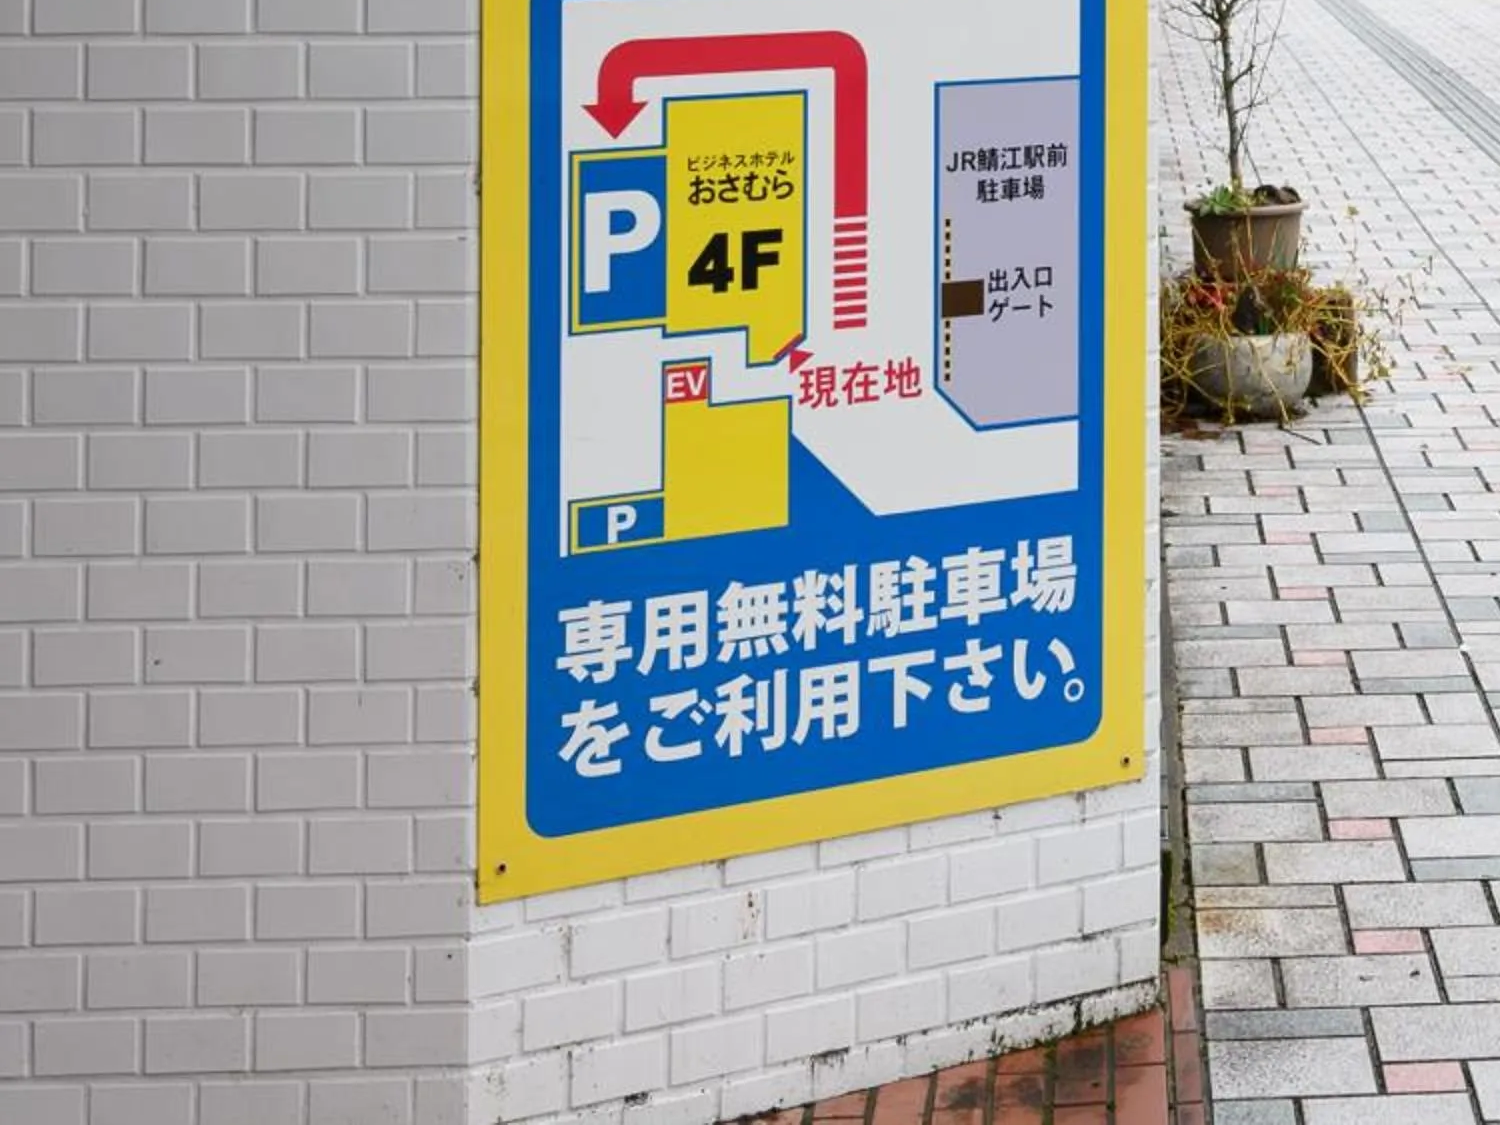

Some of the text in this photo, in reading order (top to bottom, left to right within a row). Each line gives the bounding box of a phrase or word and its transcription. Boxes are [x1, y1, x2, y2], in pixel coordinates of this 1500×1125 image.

[686, 150, 796, 171] ビジネスホテル
[945, 144, 1070, 173] JR鯖江駅前
[686, 170, 796, 206] おさむら
[976, 175, 1046, 203] 駐車場
[584, 189, 662, 294] P
[687, 228, 784, 294] 4F
[987, 266, 1054, 294] 出入口
[987, 299, 1055, 322] ゲート
[667, 369, 708, 399] EV
[799, 357, 923, 409] 現在地
[606, 505, 638, 544] P
[556, 535, 1078, 684] 専用無料駐車場
[558, 637, 1086, 779] をご利用下さい。
